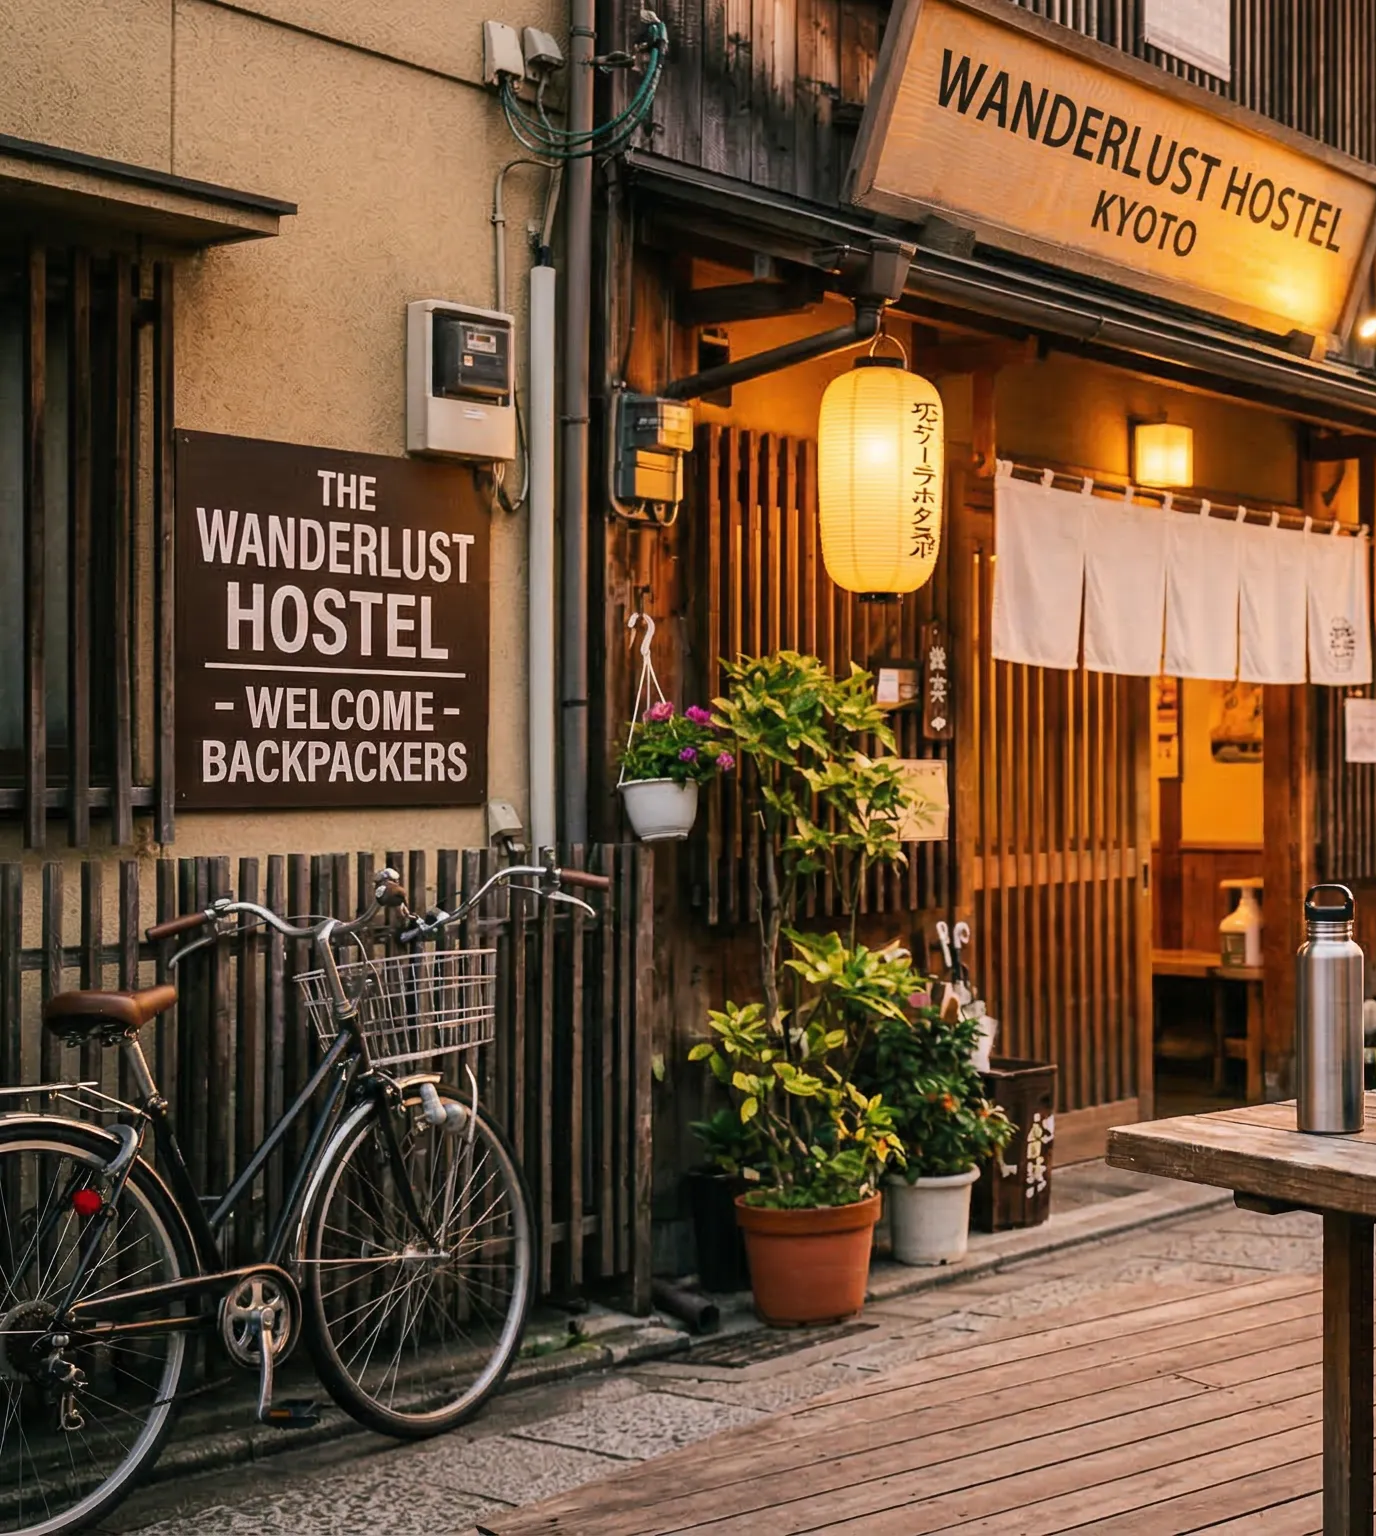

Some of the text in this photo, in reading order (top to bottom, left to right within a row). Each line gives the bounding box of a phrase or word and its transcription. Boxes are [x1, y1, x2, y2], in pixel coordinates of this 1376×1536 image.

[939, 49, 1342, 253] WANDERLUST HOSTEL
[1091, 190, 1197, 257] KYOTO
[317, 469, 376, 511] THE
[196, 507, 475, 583] WANDERLUST
[227, 581, 449, 660] HOSTEL
[245, 686, 434, 731] WELCOME
[202, 740, 468, 782] BACKPACKERS
